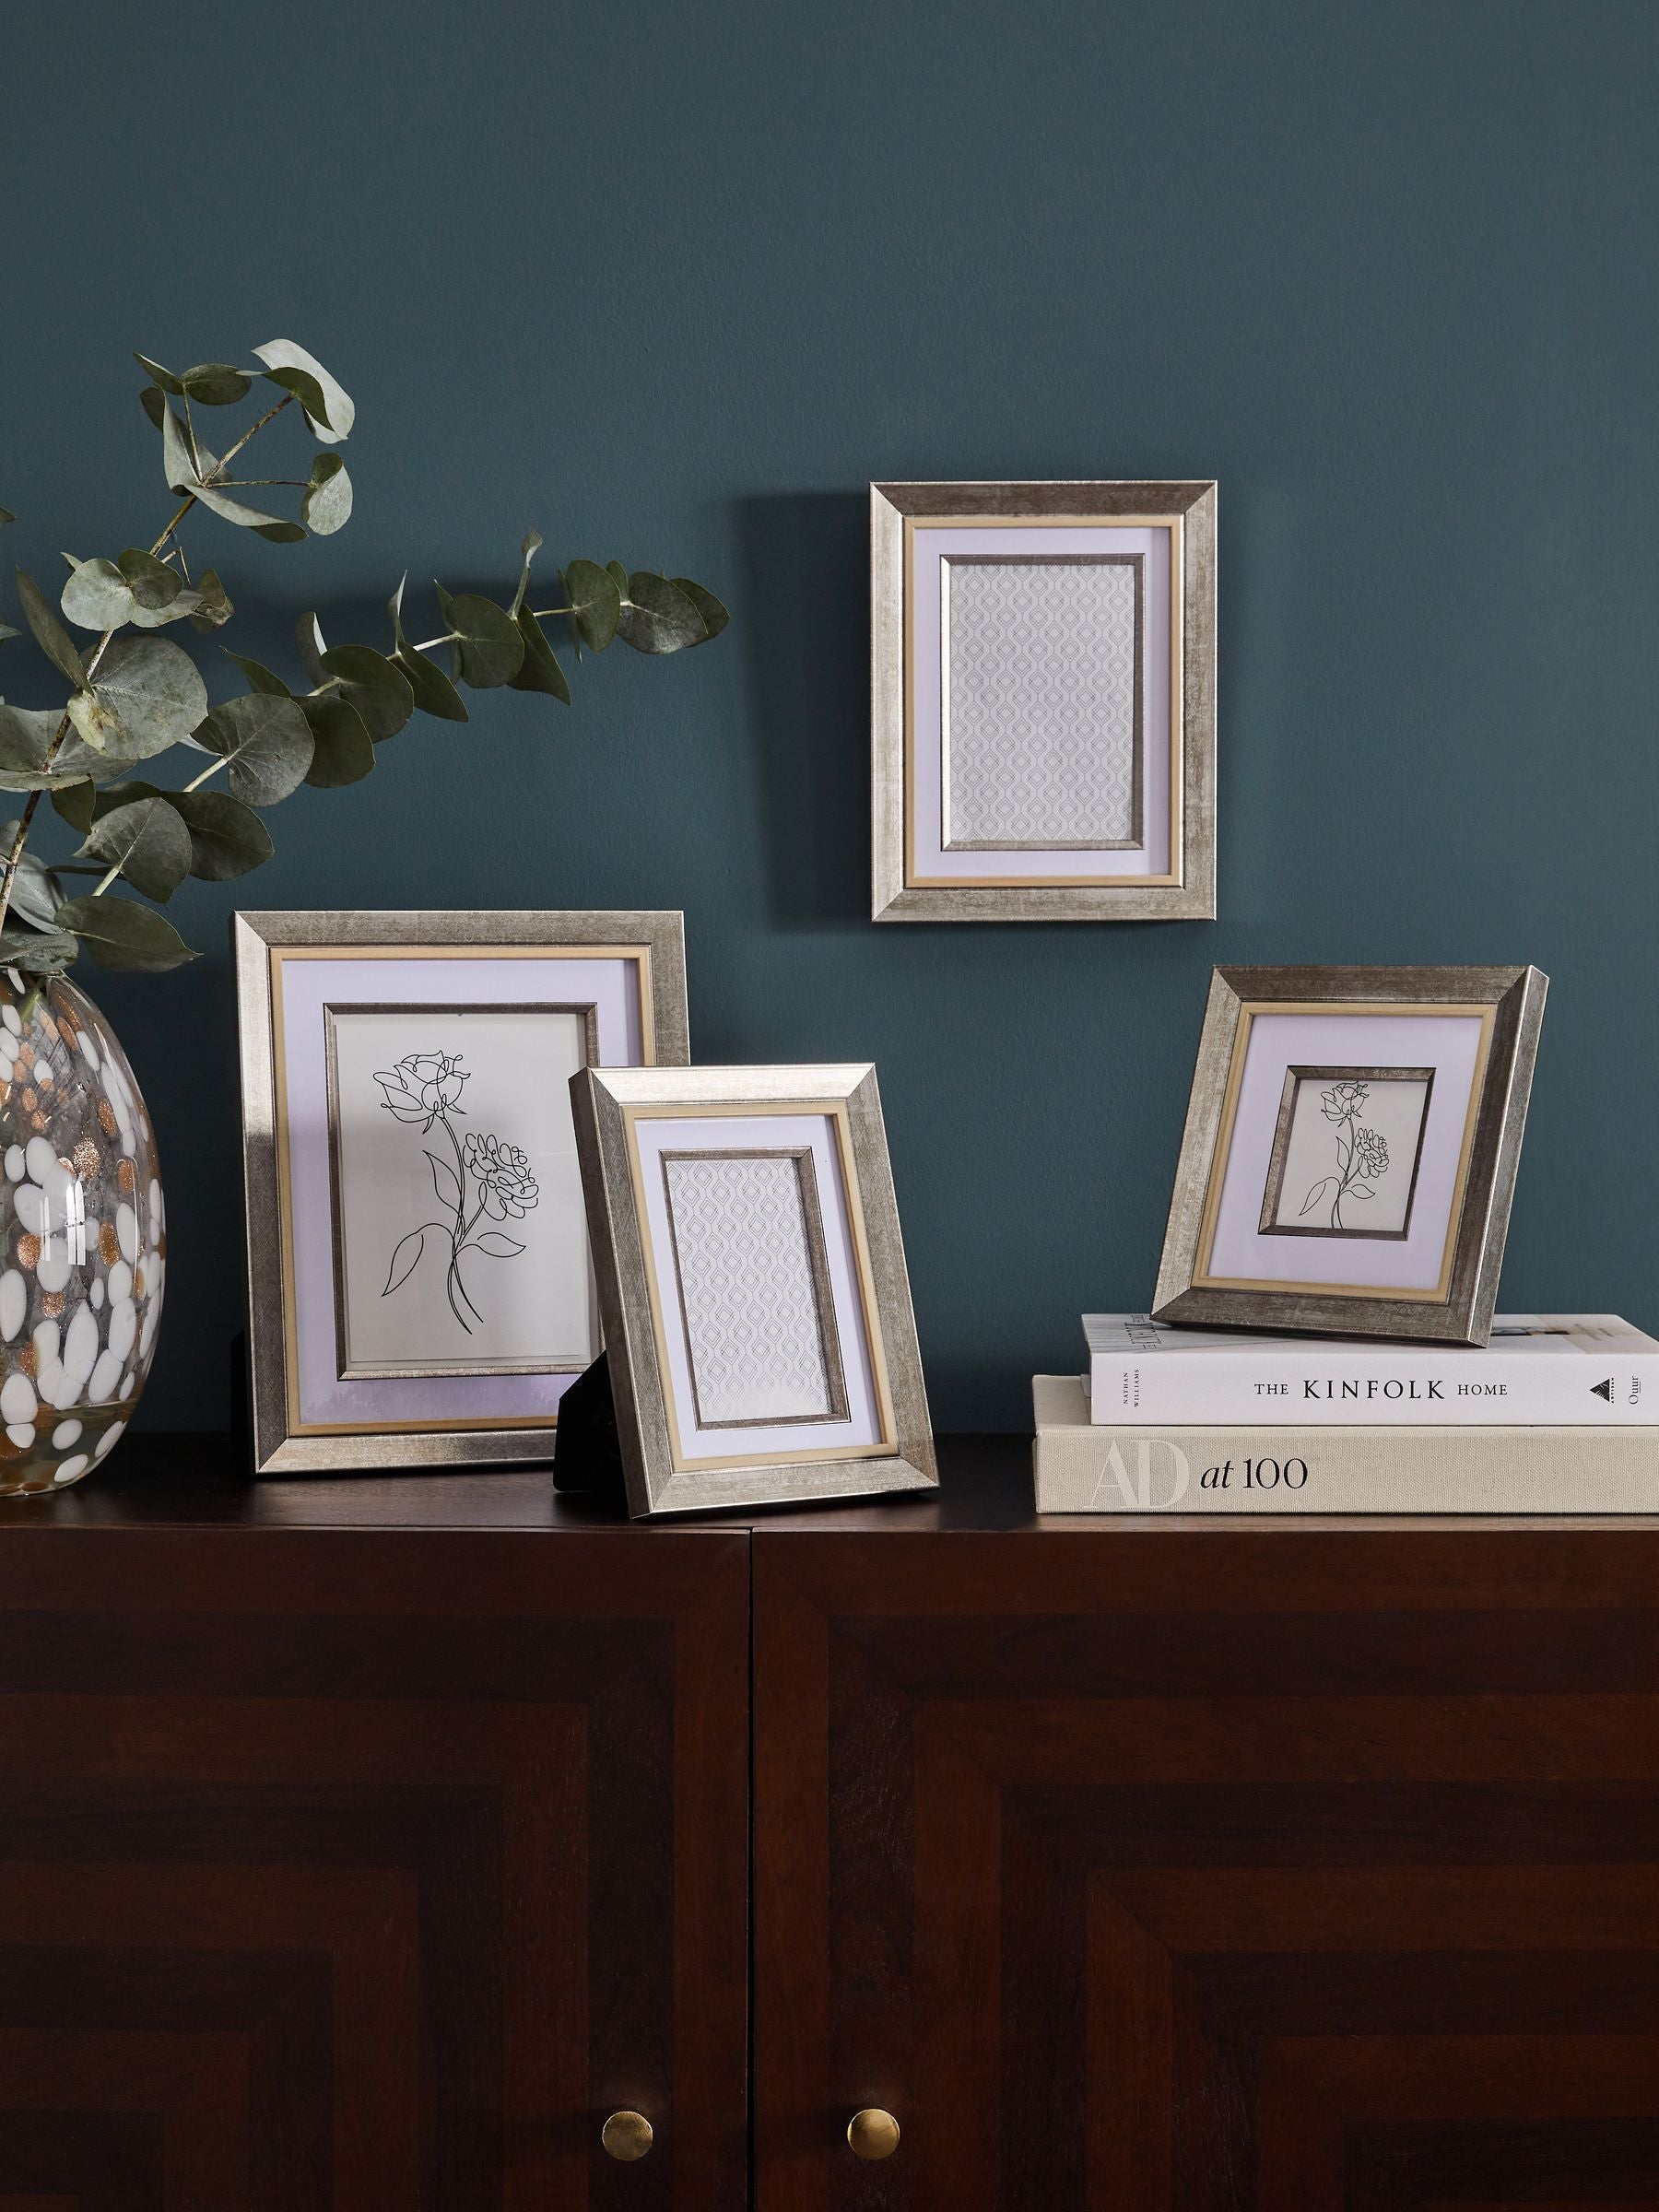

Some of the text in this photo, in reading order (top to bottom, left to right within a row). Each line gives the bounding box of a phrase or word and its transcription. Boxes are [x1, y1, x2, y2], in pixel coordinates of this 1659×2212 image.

[1254, 1380, 1509, 1399] THE KINFOLK HOME
[1629, 1375, 1639, 1405] Ouur
[1084, 1440, 1309, 1509] AD at 100
